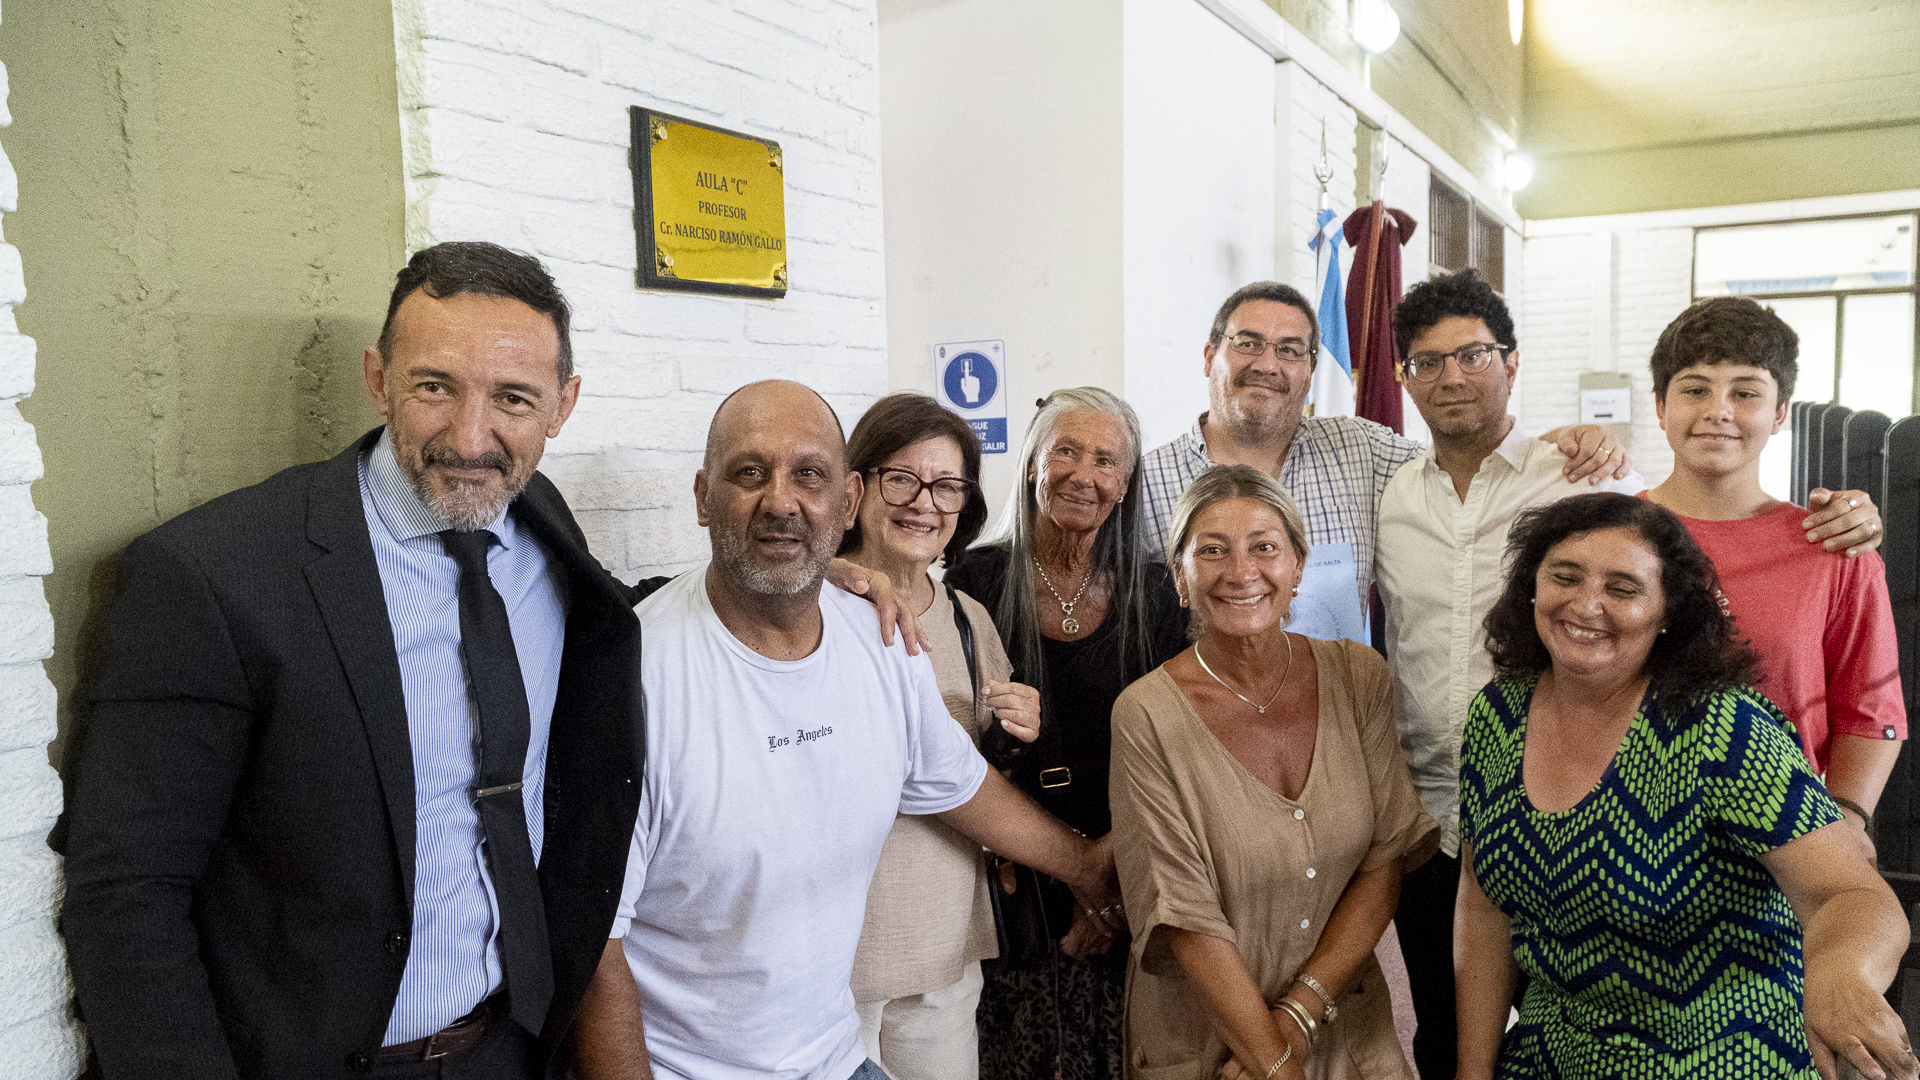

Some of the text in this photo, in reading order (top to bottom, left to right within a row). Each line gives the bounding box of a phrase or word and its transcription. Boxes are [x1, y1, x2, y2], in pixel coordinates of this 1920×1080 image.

[695, 171, 748, 195] AULA “C”
[698, 200, 747, 220] PROFESOR
[660, 221, 782, 251] Cr. NARCISO RAMÓN GALLO
[767, 725, 833, 753] Los Angeles
